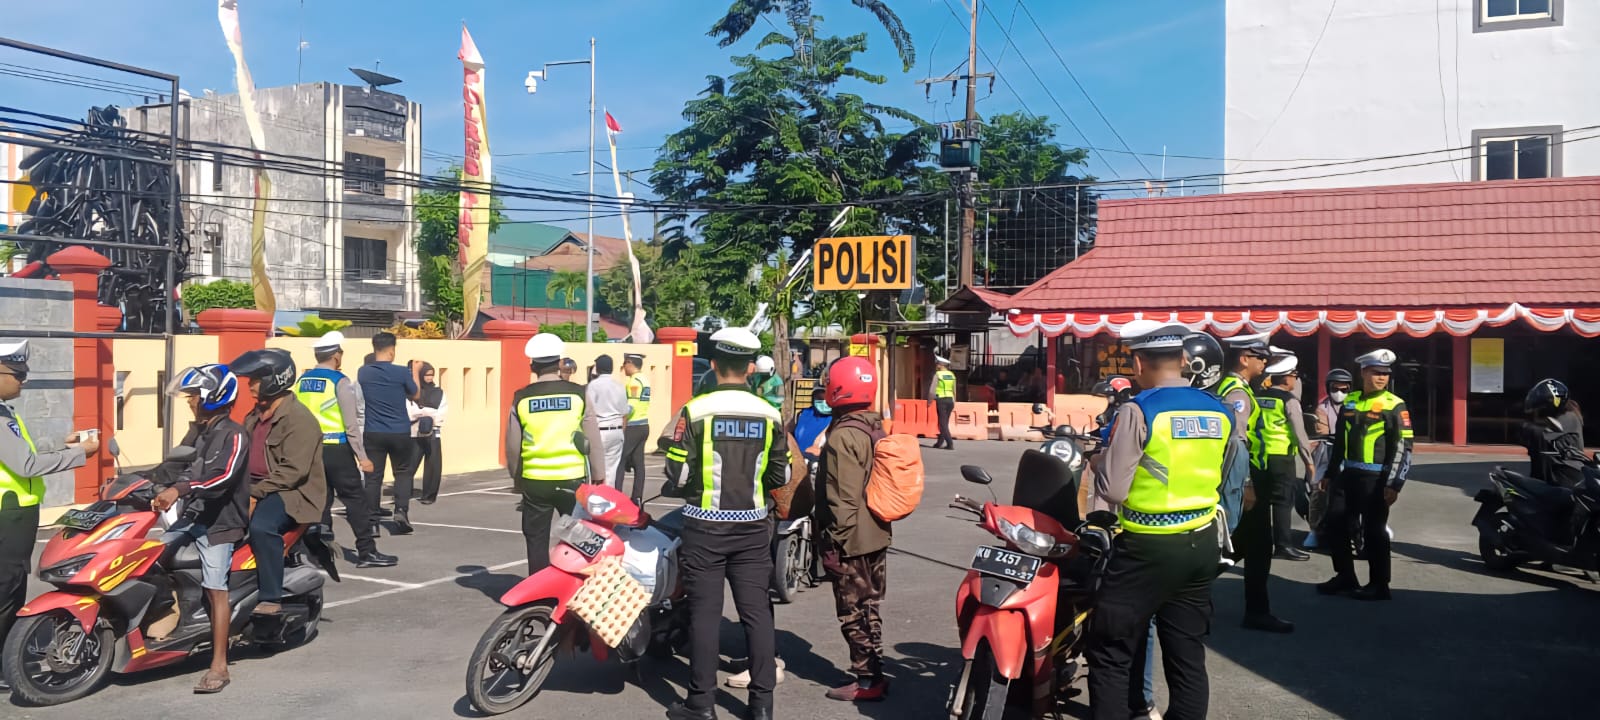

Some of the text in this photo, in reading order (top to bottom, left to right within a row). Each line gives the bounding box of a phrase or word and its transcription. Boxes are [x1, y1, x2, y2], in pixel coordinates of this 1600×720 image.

[819, 240, 905, 284] POLISI
[530, 398, 570, 411] POLISI
[714, 420, 763, 438] POLISI
[976, 547, 991, 558] KU
[995, 552, 1021, 565] 2457
